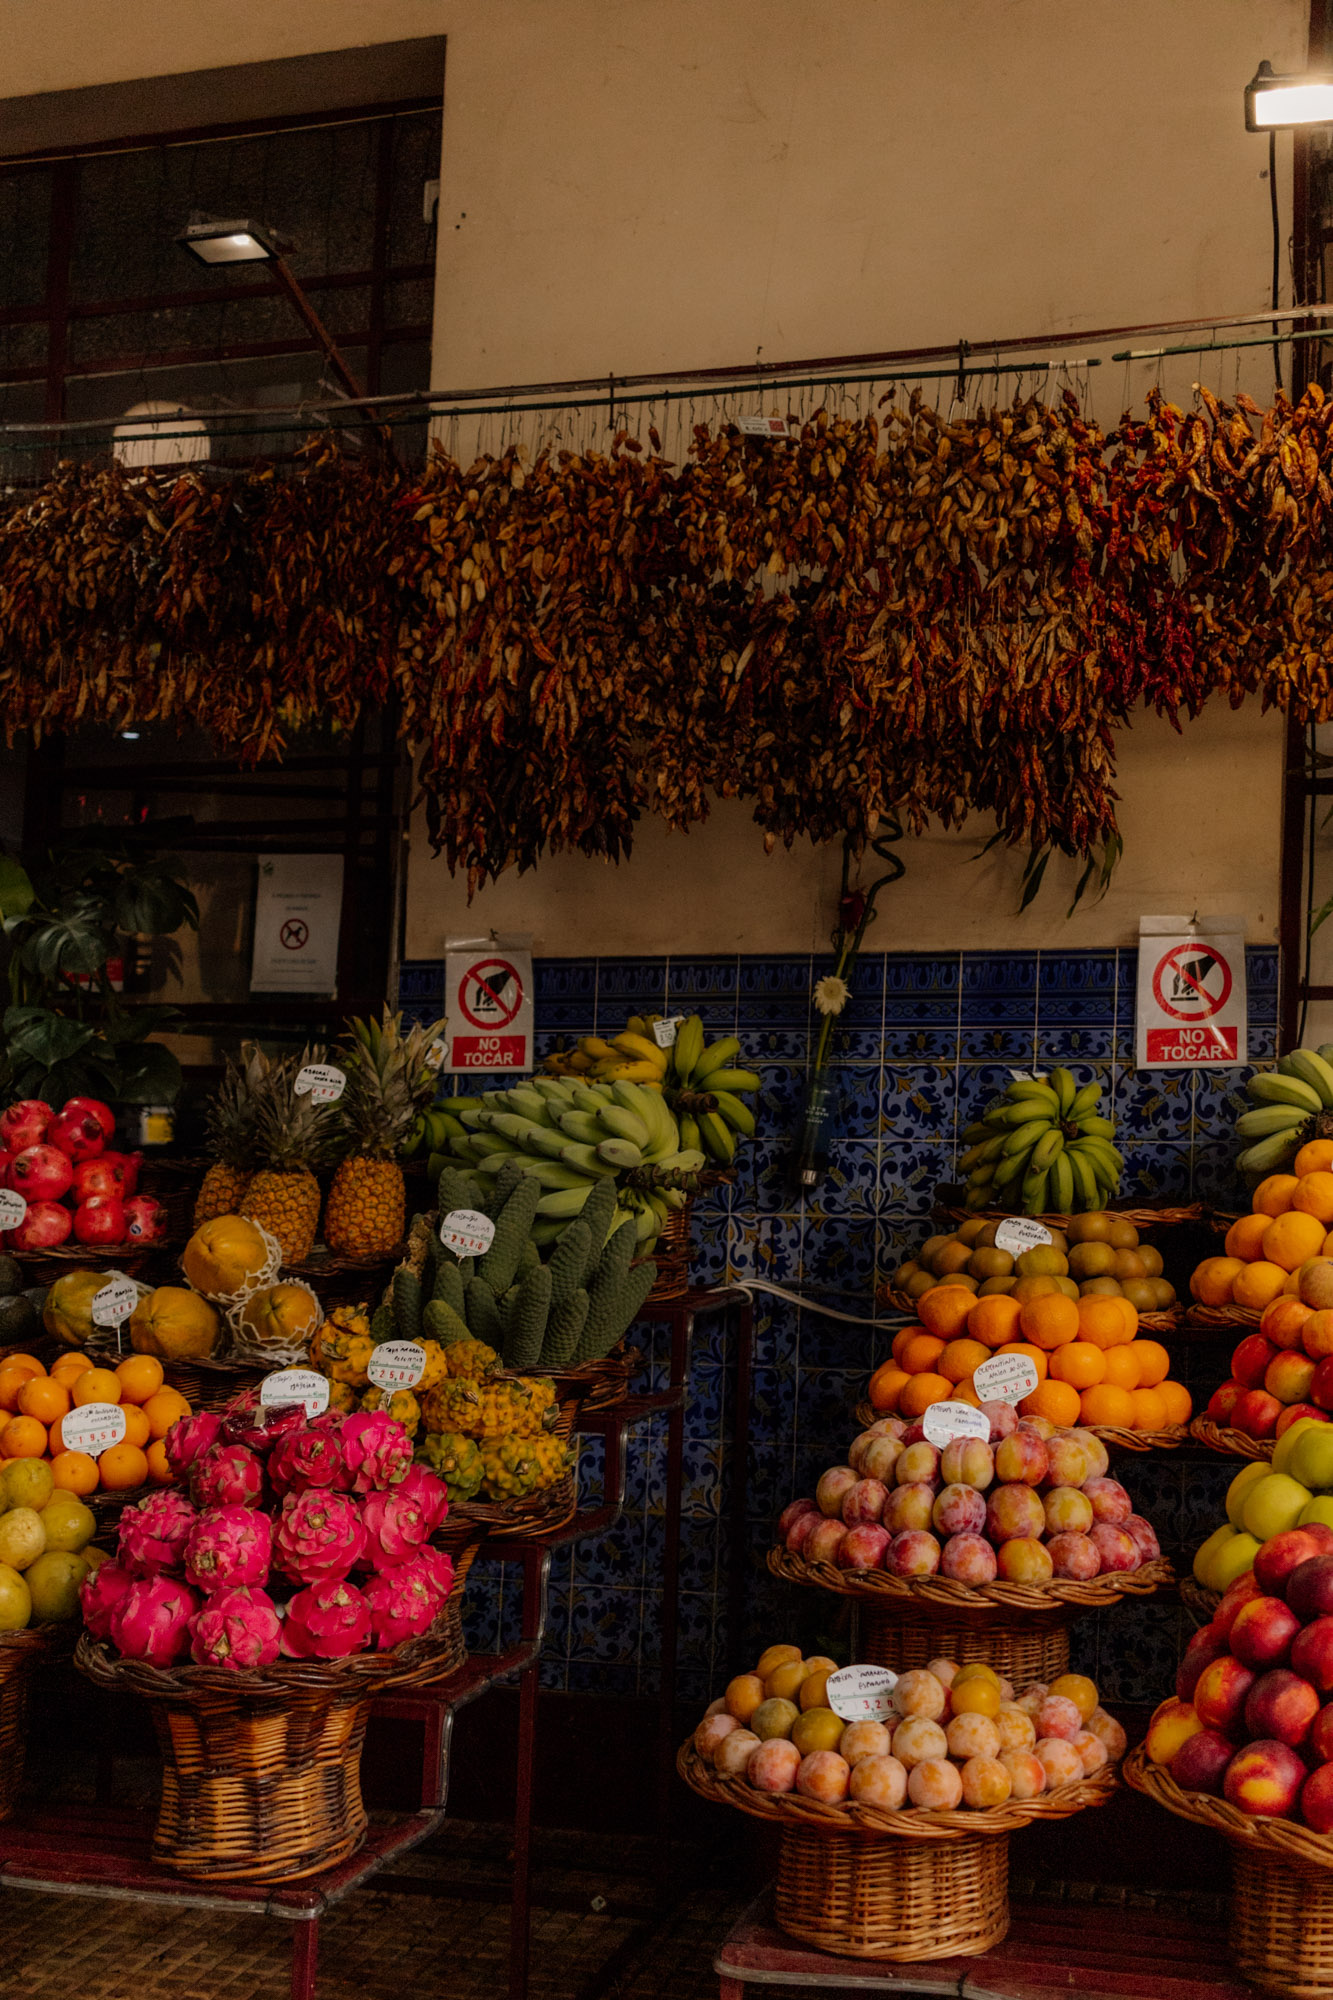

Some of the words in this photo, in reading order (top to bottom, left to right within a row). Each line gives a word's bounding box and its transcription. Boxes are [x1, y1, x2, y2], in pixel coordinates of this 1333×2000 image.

[1179, 1030, 1205, 1044] NO
[479, 1038, 500, 1051] NO
[464, 1052, 513, 1065] TOCAR
[1161, 1046, 1223, 1060] TOCAR
